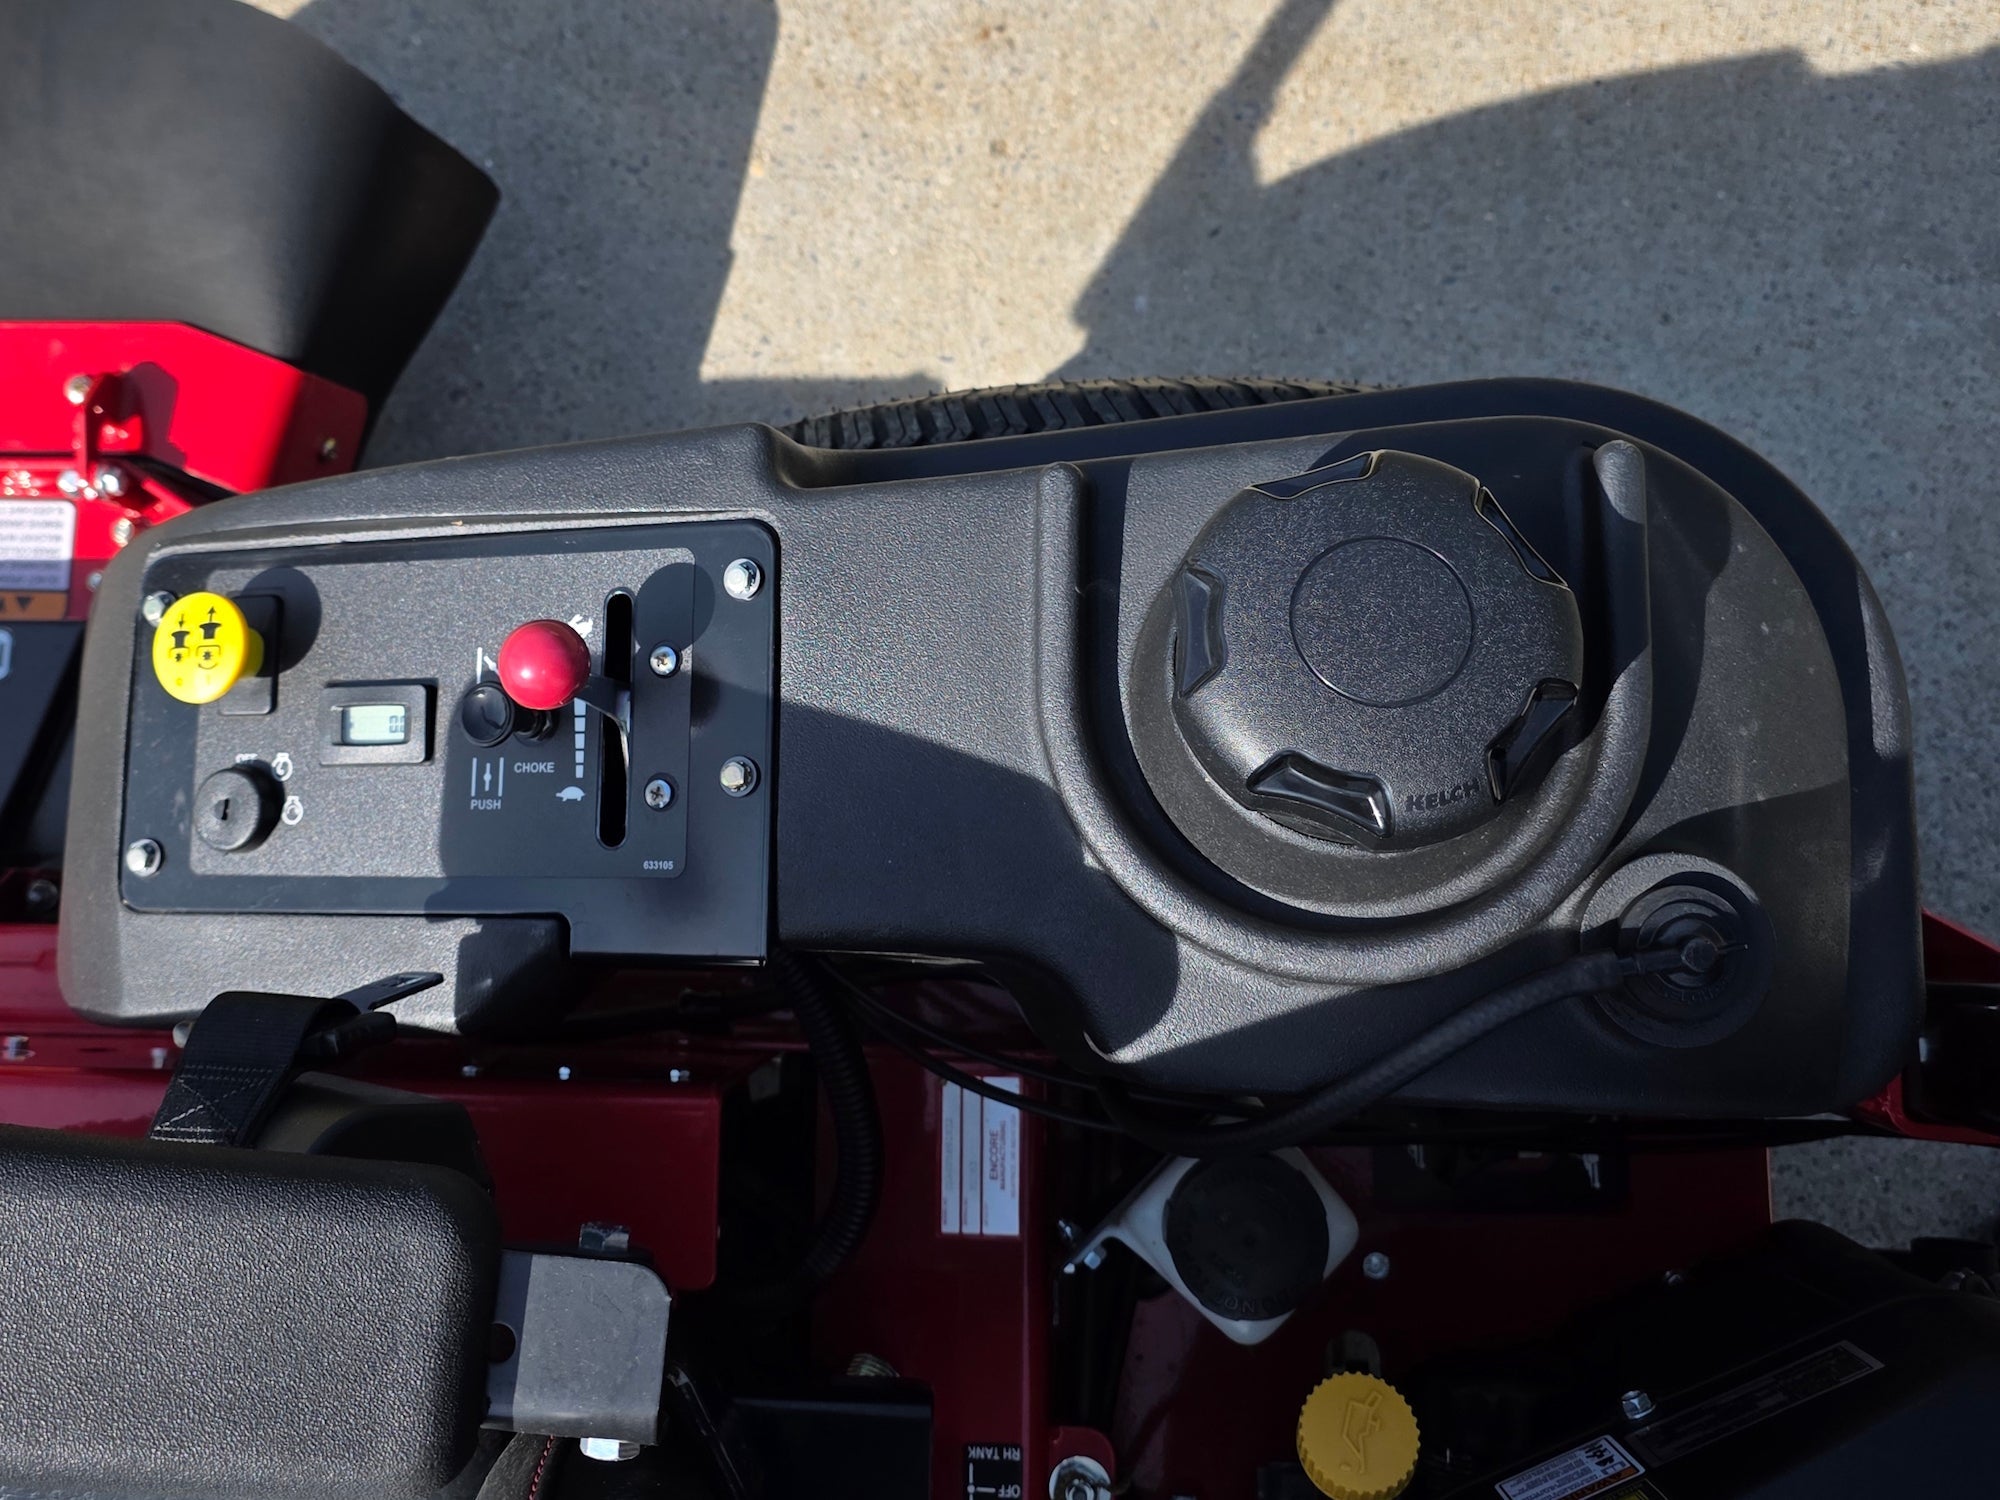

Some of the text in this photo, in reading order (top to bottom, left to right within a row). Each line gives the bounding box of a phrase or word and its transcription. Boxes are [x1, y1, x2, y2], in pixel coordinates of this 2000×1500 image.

[513, 762, 555, 773] CHOKE
[1405, 777, 1480, 813] KELCH
[470, 799, 502, 810] PUSH
[643, 860, 674, 870] 633105
[989, 1128, 999, 1181] ENCORE
[967, 1446, 1020, 1461] RH TANK
[998, 1484, 1020, 1498] OFF
